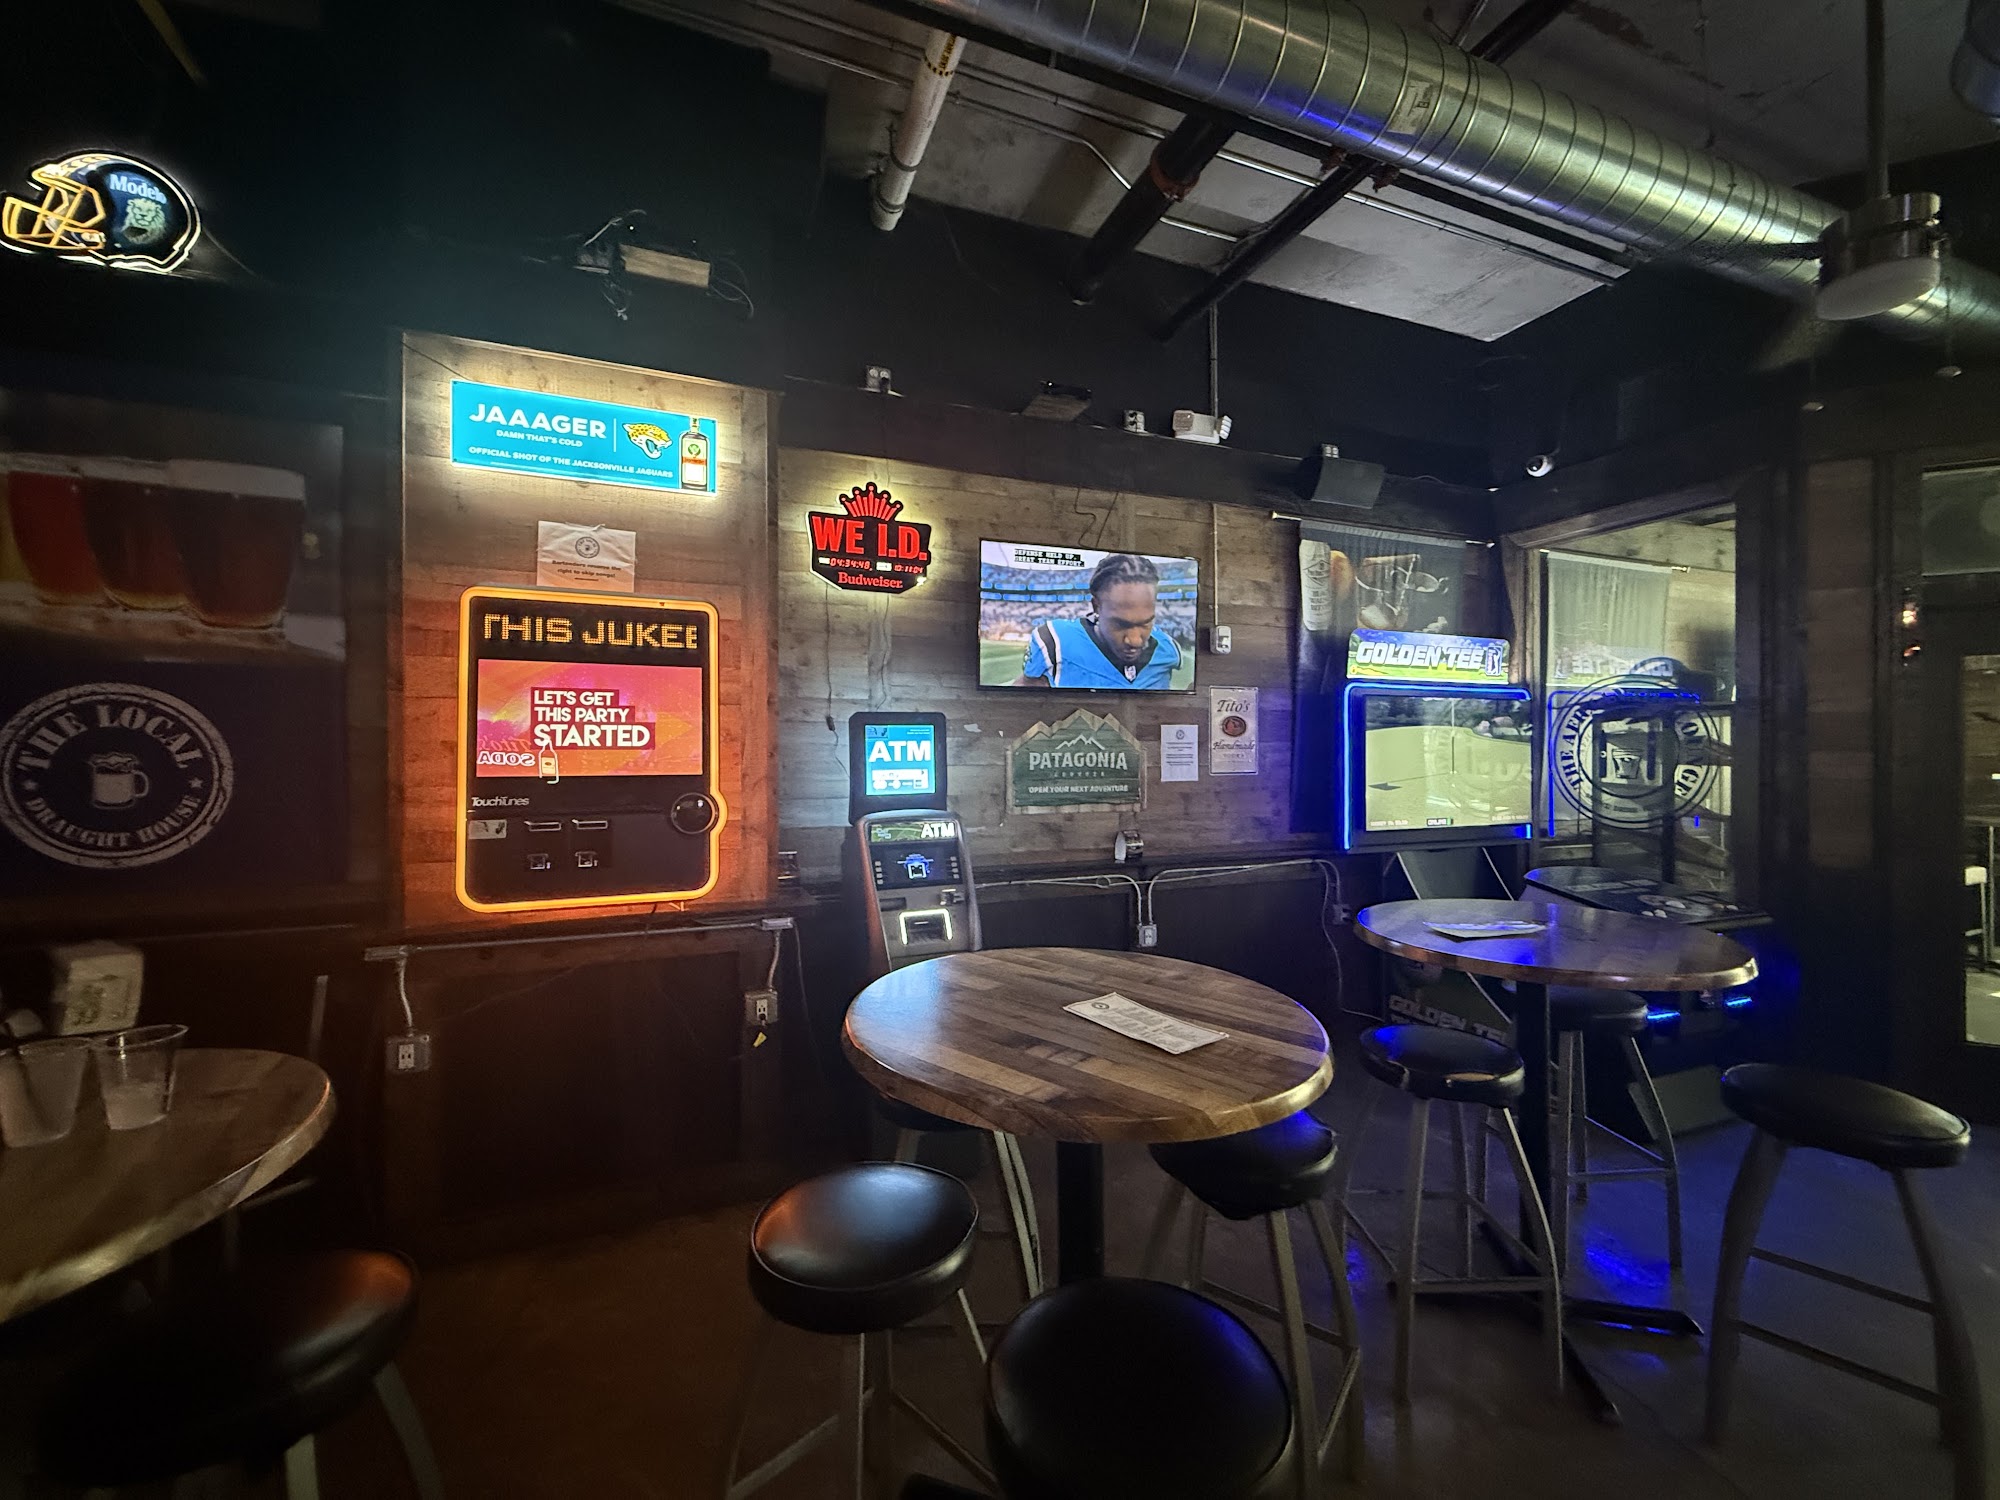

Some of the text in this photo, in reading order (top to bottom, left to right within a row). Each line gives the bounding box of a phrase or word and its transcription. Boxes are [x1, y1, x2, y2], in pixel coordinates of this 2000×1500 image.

[109, 173, 167, 204] Modelo
[469, 403, 606, 438] JAAAGER
[496, 429, 583, 448] DAMN THAT'S COLD
[469, 446, 673, 479] OFFICIAL SHOT OF THE JACKSONVILLE JAGUARS
[811, 515, 928, 561] WE I.D.
[1356, 641, 1446, 668] GOLDEN
[1447, 648, 1484, 670] TEE
[534, 690, 614, 706] LET'S GET
[1217, 700, 1250, 713] Tito's
[534, 706, 629, 722] THIS PARTY
[16, 704, 203, 771] THE LOCAL
[534, 724, 650, 747] STARTED
[869, 740, 931, 763] ATM
[1029, 752, 1128, 771] PATAGONIA
[1560, 751, 1585, 790] THE
[471, 796, 530, 807] TouchTunes
[1028, 786, 1049, 794] OPEN
[26, 795, 201, 847] DRAUGHT HOUSE
[921, 823, 955, 839] ATM
